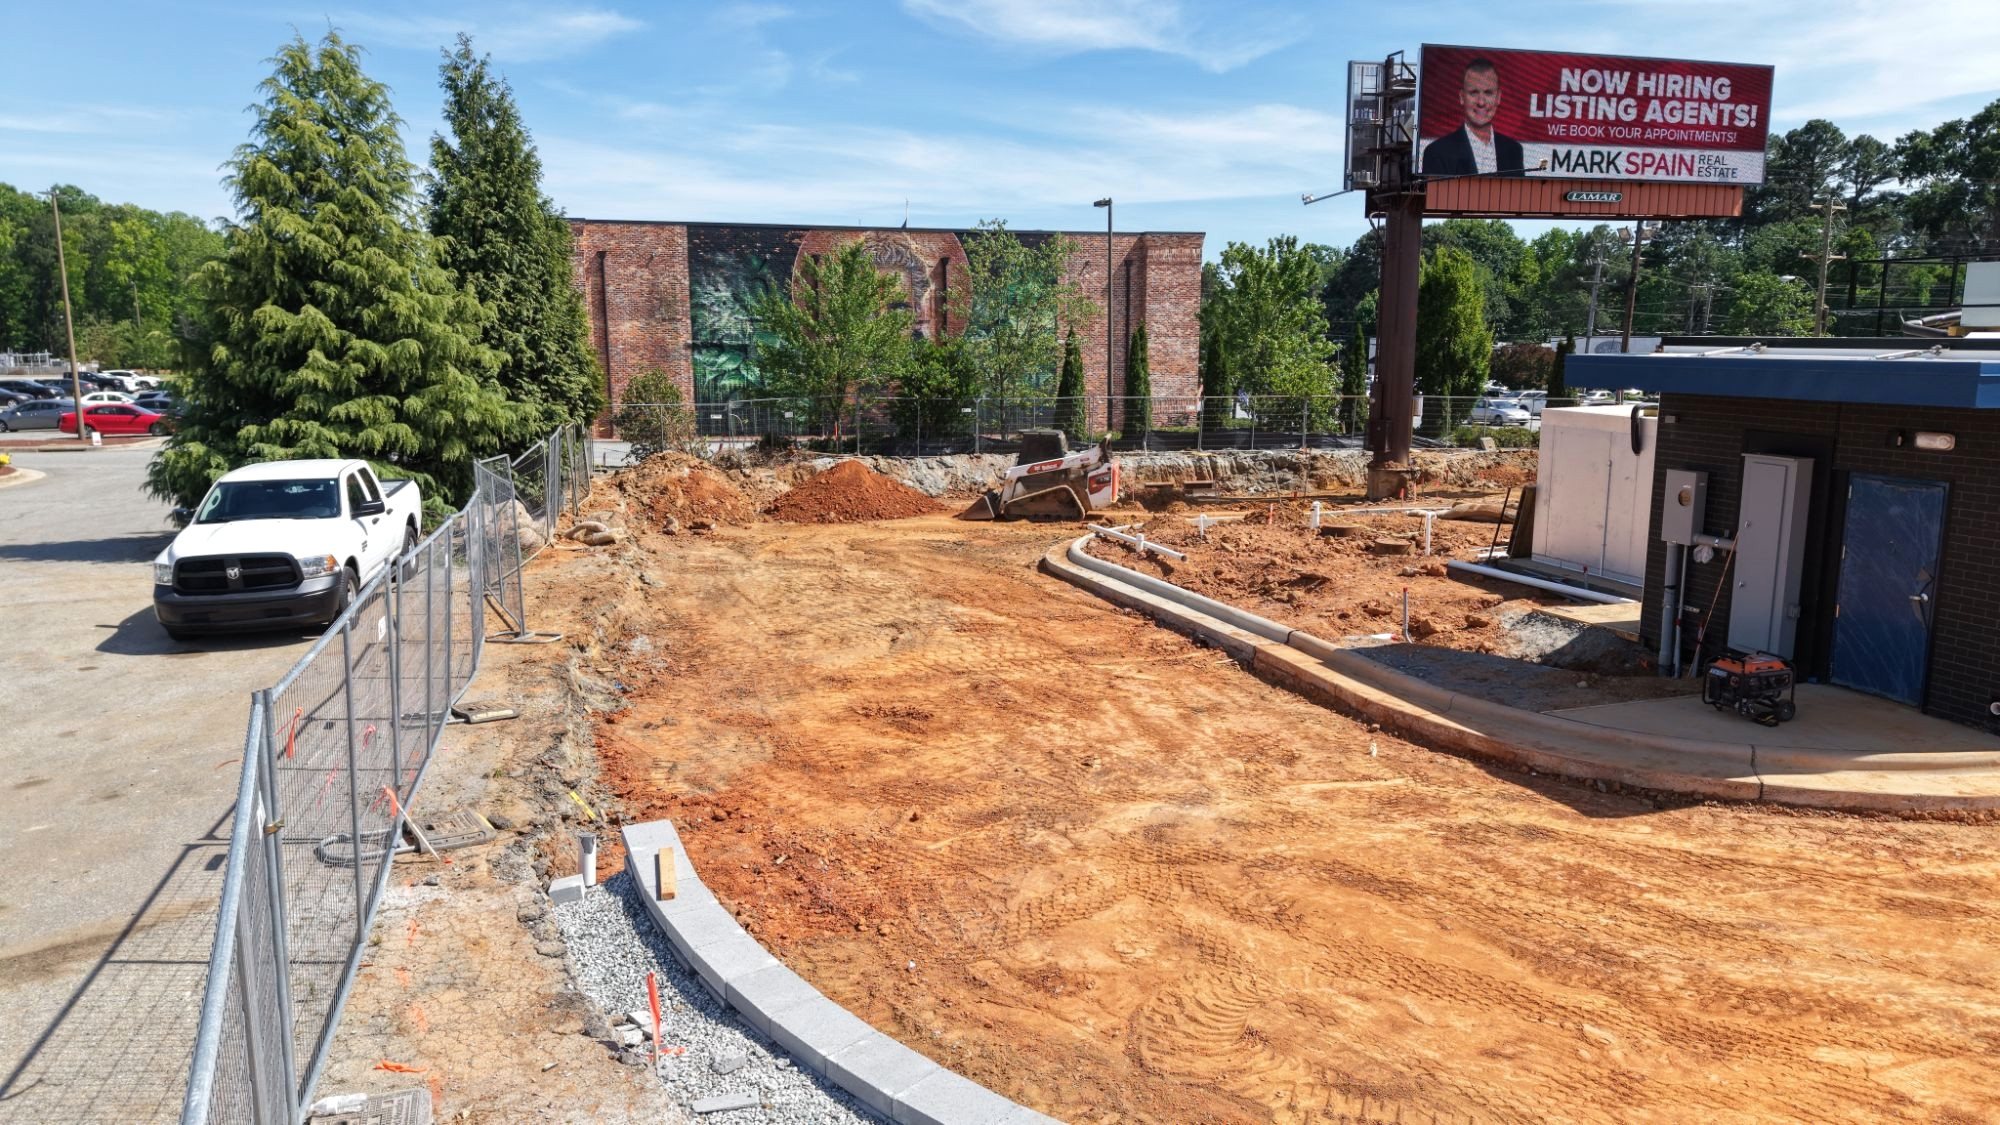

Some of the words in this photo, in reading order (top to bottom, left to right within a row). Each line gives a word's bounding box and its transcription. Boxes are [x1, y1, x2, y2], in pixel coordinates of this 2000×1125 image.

[1560, 68, 1630, 95] NOW
[1637, 72, 1731, 100] HIRING
[1529, 93, 1637, 122] LISTING
[1644, 99, 1758, 127] AGENTS!
[1548, 124, 1567, 136] WE
[1570, 125, 1604, 138] BOOK
[1608, 127, 1641, 140] YOUR
[1644, 130, 1737, 143] APPOINTMENTS!
[1551, 149, 1621, 174] MARK
[1625, 152, 1695, 177] SPAIN
[1699, 154, 1728, 166] REAL
[1697, 166, 1738, 179] ESTATE
[1572, 193, 1617, 201] LAMAR
